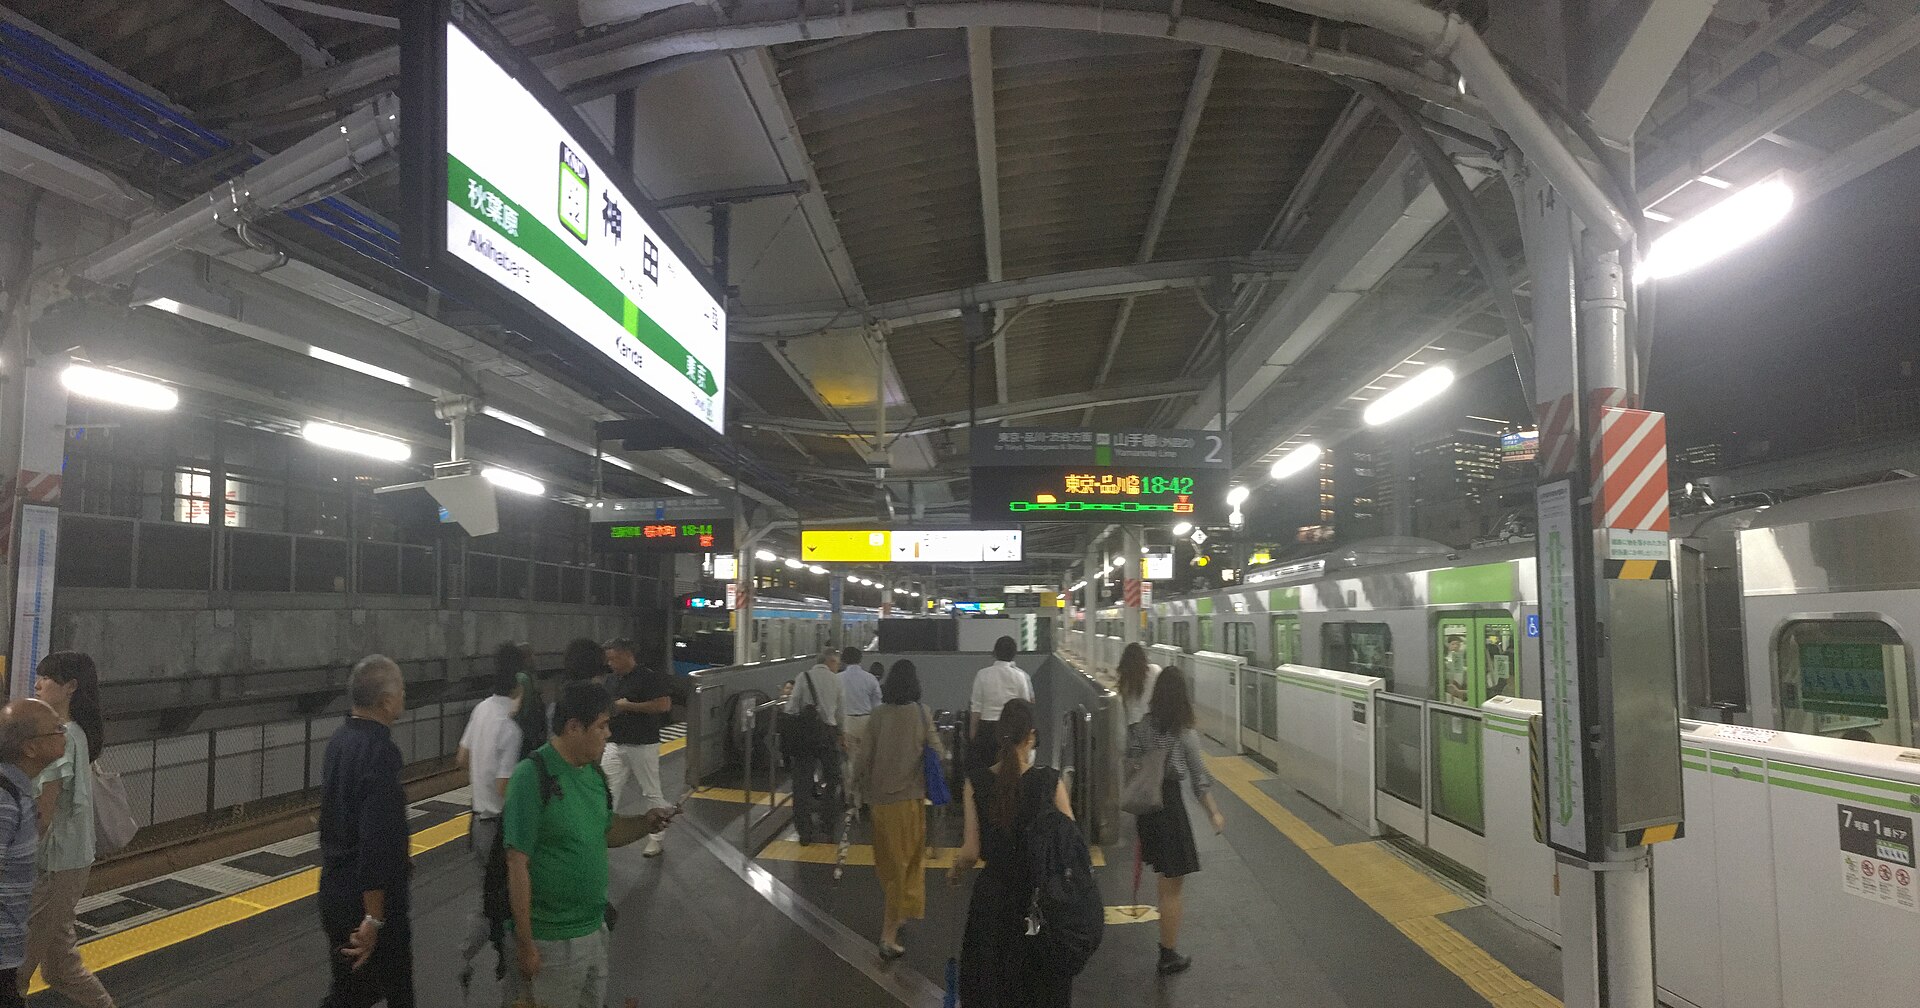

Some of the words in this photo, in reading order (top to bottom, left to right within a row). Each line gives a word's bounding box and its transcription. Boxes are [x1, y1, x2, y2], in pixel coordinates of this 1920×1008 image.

[467, 178, 519, 237] 秋葉原
[602, 189, 658, 287] 神田
[1204, 435, 1223, 462] 2
[1141, 476, 1194, 494] 18:42
